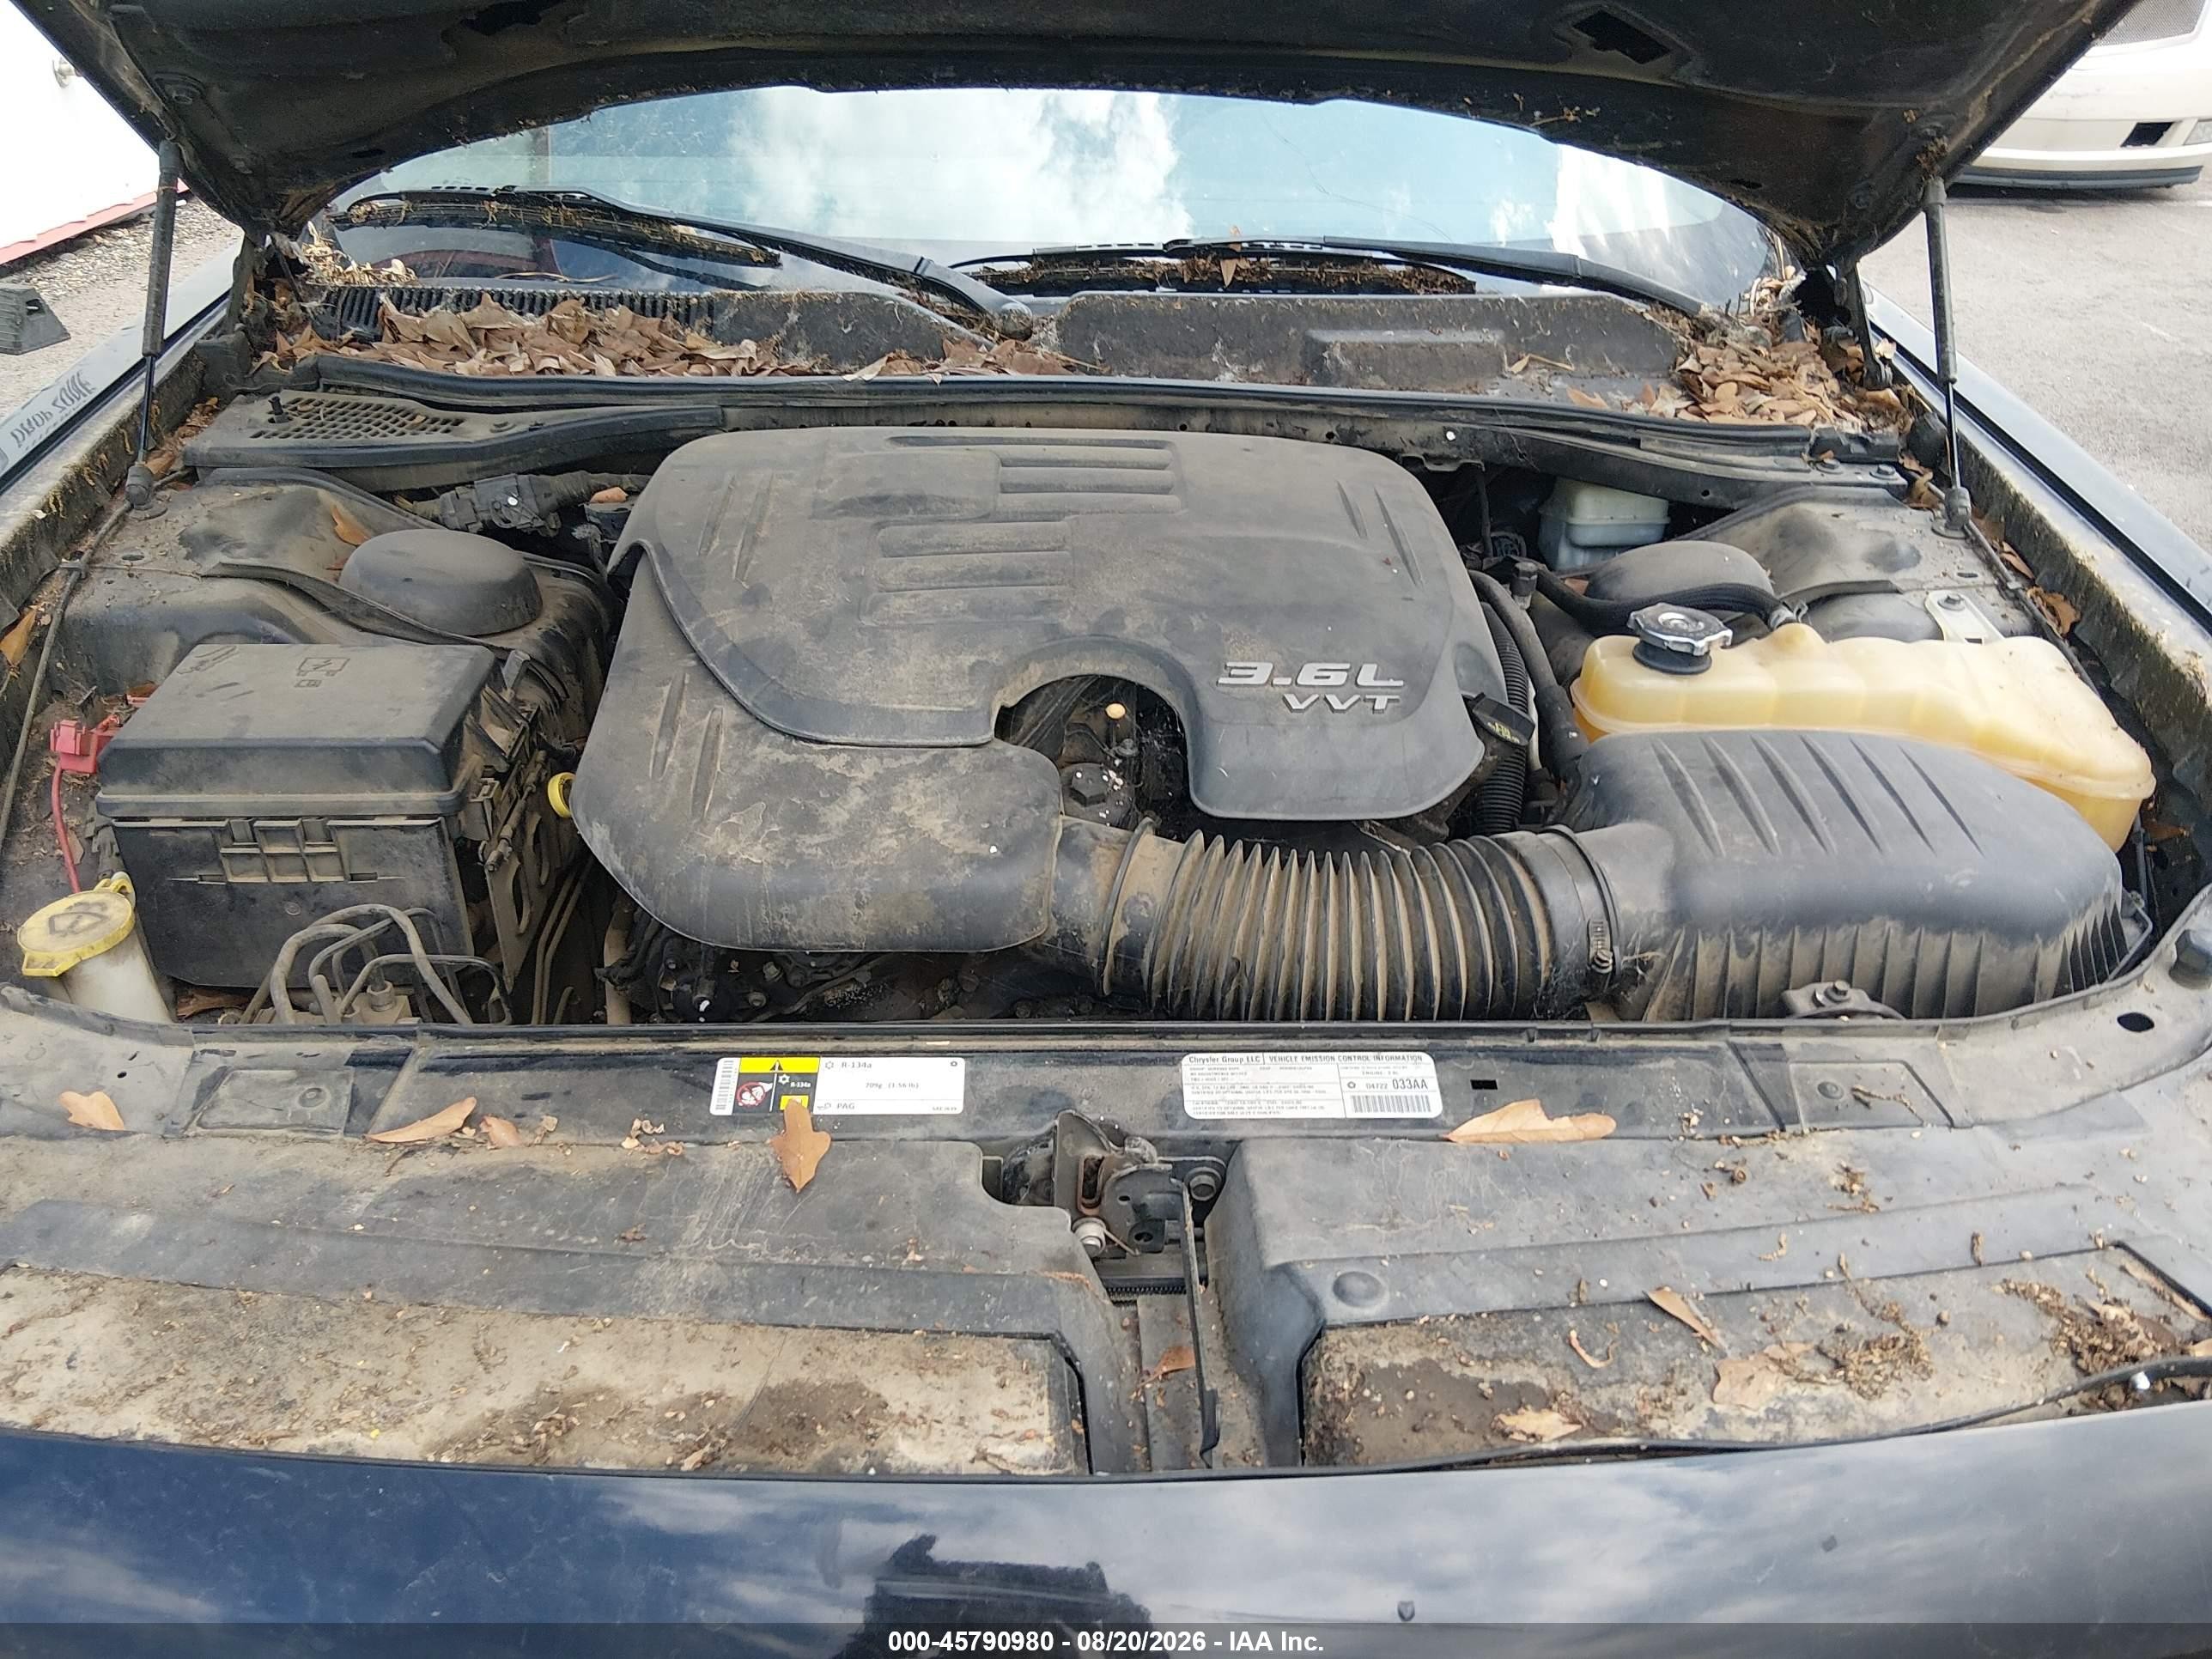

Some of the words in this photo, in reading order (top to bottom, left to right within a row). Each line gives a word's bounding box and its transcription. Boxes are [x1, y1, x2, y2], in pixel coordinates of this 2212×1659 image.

[1217, 661, 1404, 687] 3.6L
[1282, 694, 1401, 714] VVT
[1392, 1079, 1428, 1090] 033AA
[836, 1102, 855, 1110] PAG
